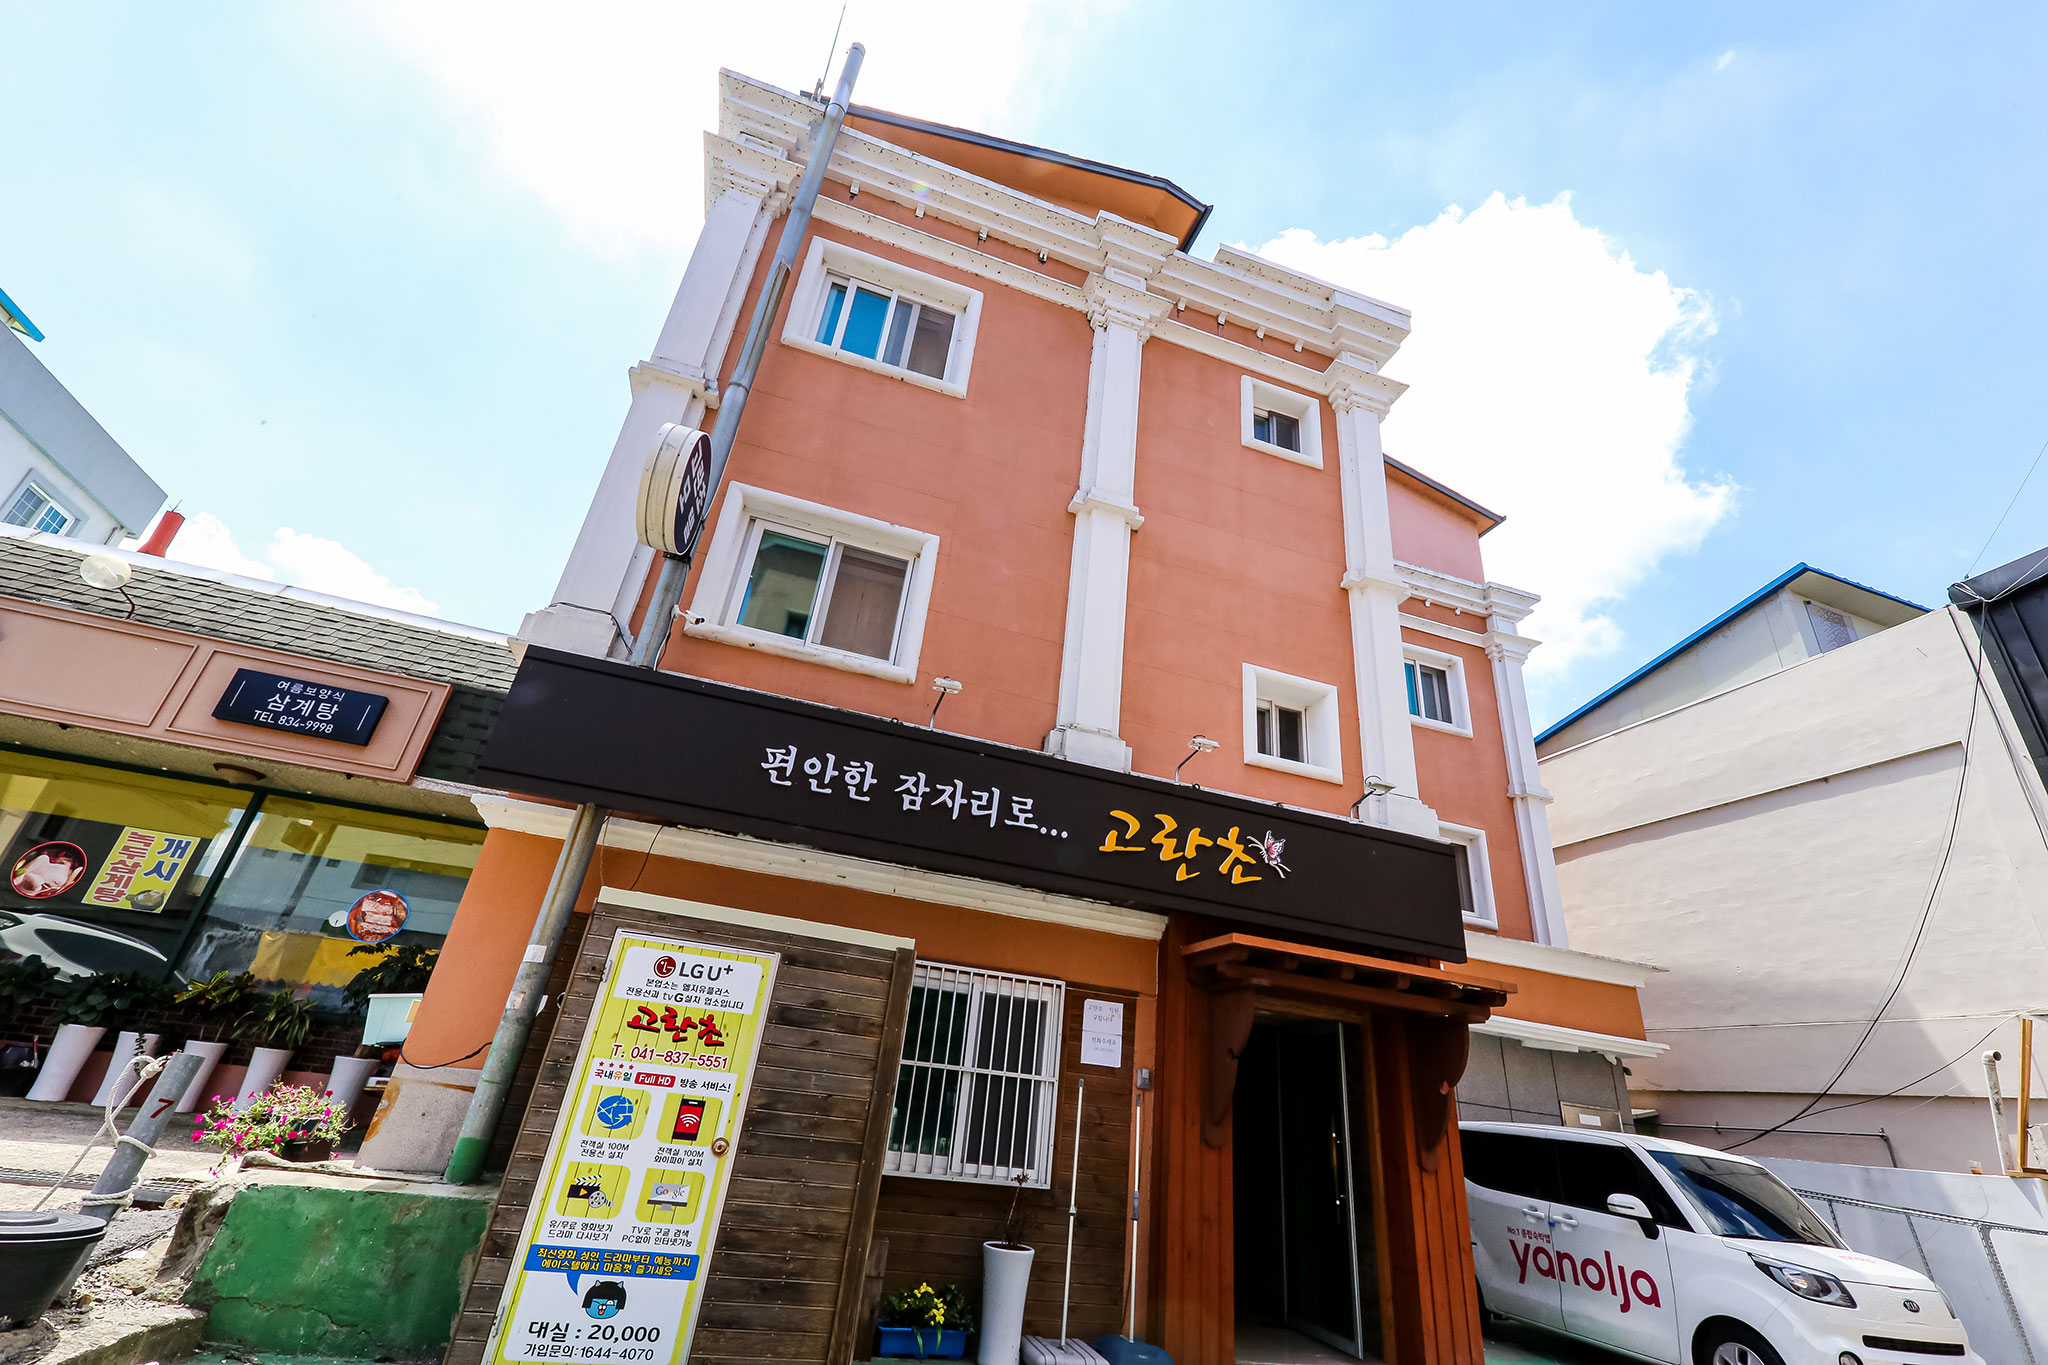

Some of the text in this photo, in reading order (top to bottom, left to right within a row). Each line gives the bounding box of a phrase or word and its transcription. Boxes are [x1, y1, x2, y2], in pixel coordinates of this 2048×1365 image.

[277, 680, 345, 702] 여름보양식
[267, 693, 339, 721] 삼계탕
[253, 710, 334, 734] TEL 834-9998
[761, 745, 878, 802] 편안한
[1099, 810, 1262, 884] 고란초
[93, 831, 156, 903] 녹두삼계탕
[143, 837, 192, 881] 개시
[704, 997, 744, 1010] 업소입니다
[627, 1005, 725, 1047] 고란초
[630, 1046, 728, 1069] 041-837-5551
[594, 1069, 731, 1093] 국내유일 Full HD 방송 서비스!
[150, 1098, 175, 1119] 7
[608, 1142, 630, 1151] 100M
[684, 1149, 704, 1158] 100M
[547, 1229, 609, 1241] 드라마 다시보기
[581, 1222, 613, 1233] 영화보기
[631, 1226, 651, 1235] TV로
[655, 1227, 671, 1237] 구글
[603, 1252, 651, 1264] 드라마부터
[654, 1255, 691, 1267] 예능까지
[1509, 1239, 1662, 1314] yanolja
[528, 1321, 570, 1343] 대실
[587, 1324, 661, 1344] 20,000
